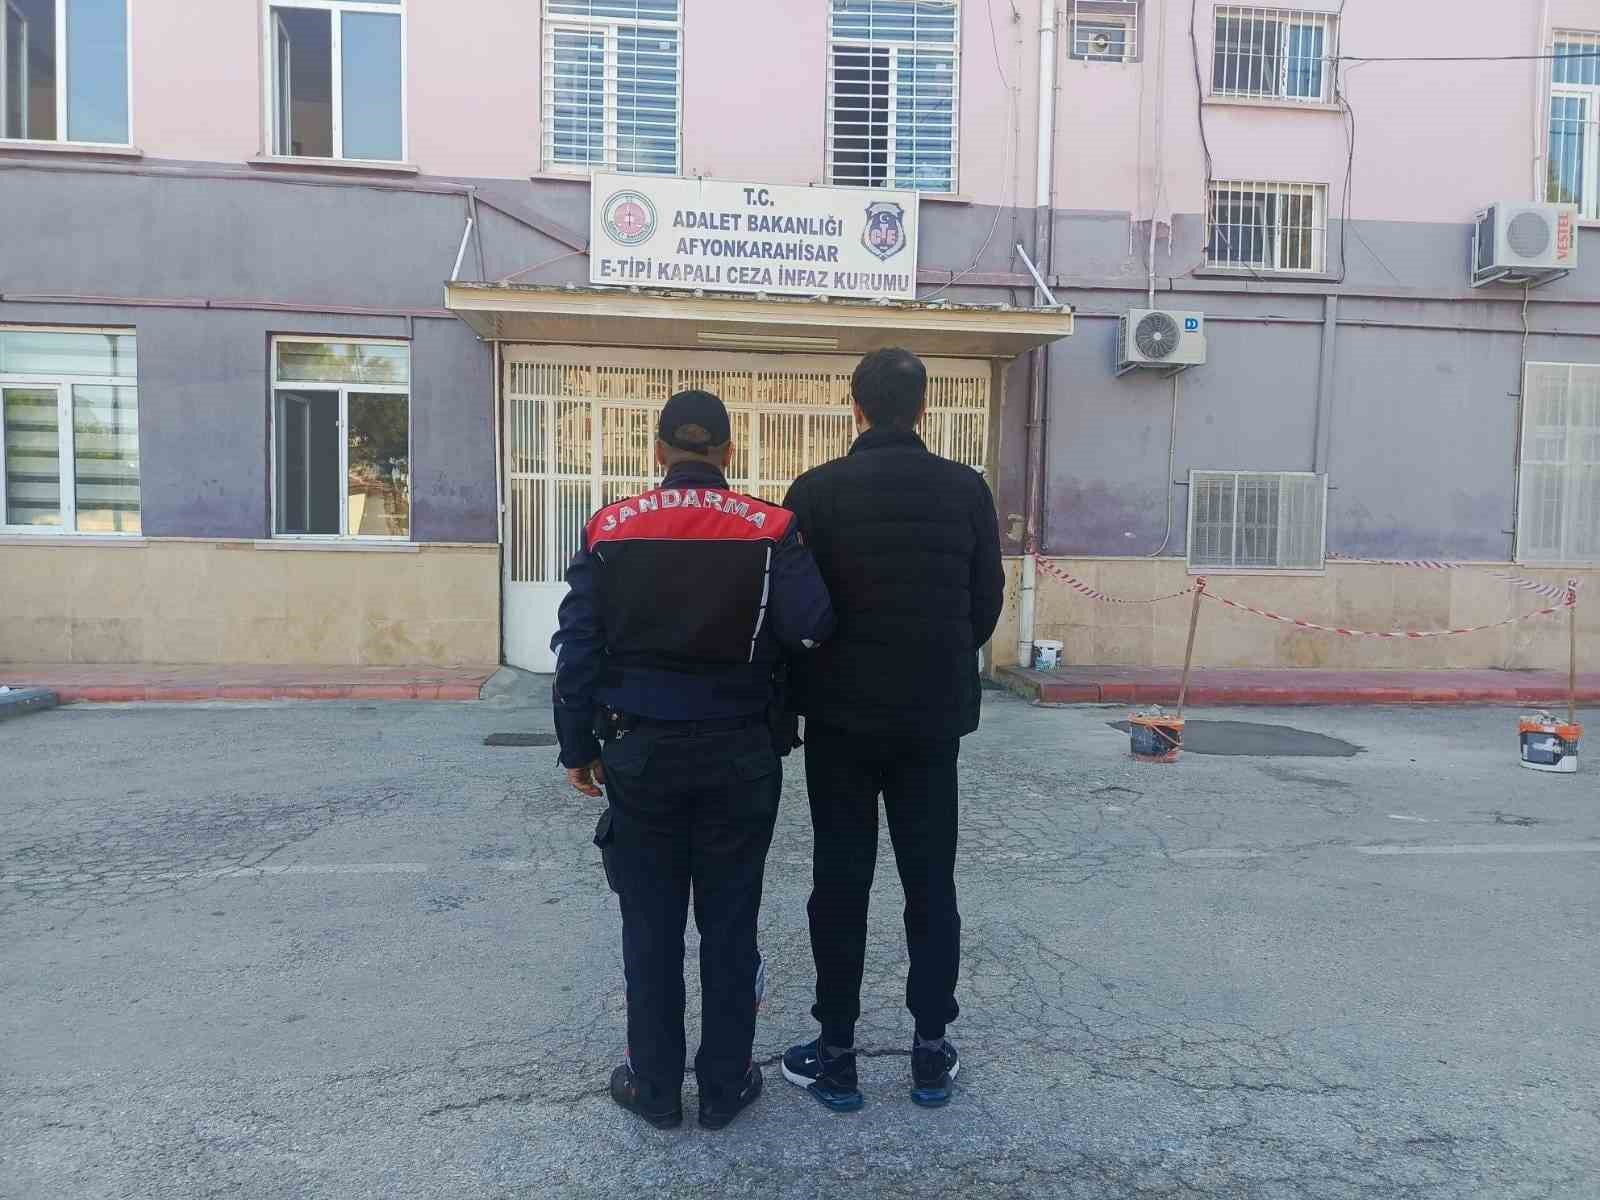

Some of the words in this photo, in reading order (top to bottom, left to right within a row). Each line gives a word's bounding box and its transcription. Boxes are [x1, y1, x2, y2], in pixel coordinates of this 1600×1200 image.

[743, 188, 775, 206] T.C.
[672, 210, 742, 231] ADALET
[747, 214, 843, 237] BAKANLIĞI
[676, 237, 839, 263] AFYONKARAHİSAR
[600, 256, 652, 280] E-TİPİ
[657, 262, 720, 283] KAPALI
[727, 266, 773, 286] CEZA
[778, 265, 829, 288] İNFAZ
[833, 271, 909, 292] KURUMU
[602, 489, 766, 531] JANDARMA
